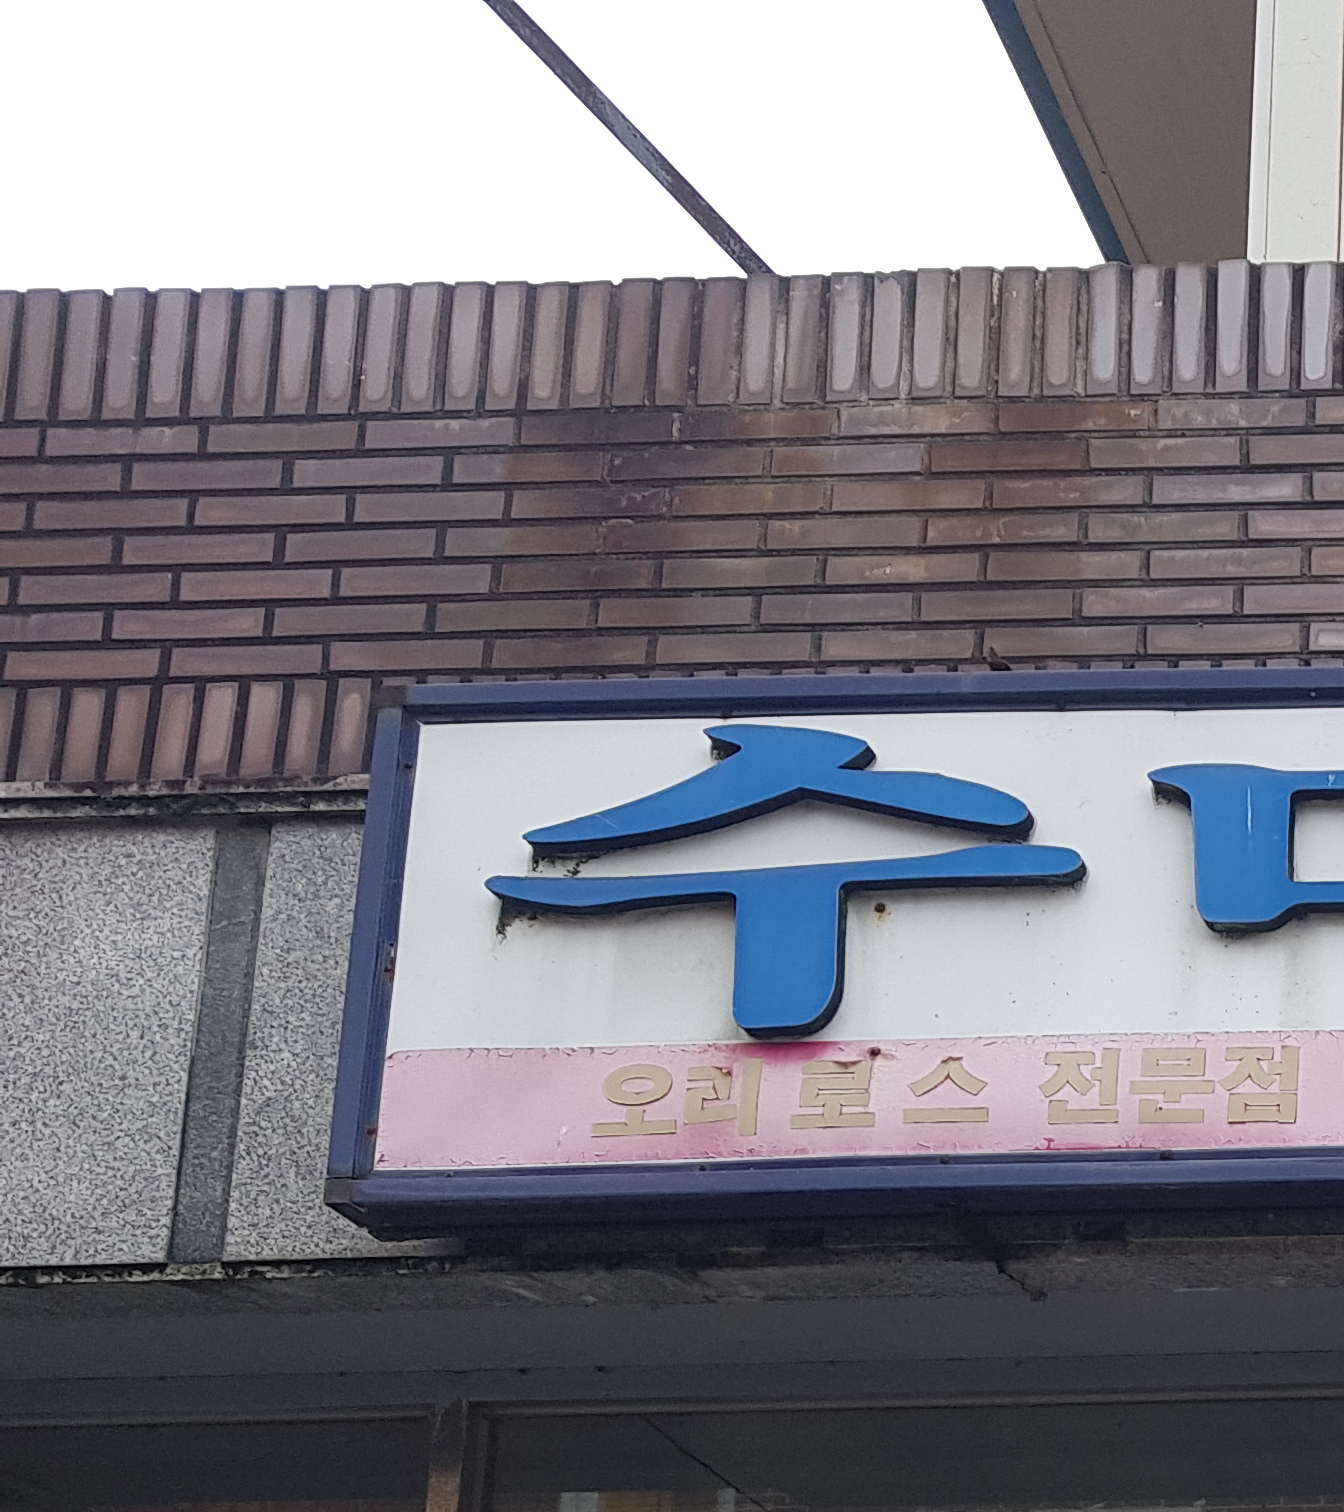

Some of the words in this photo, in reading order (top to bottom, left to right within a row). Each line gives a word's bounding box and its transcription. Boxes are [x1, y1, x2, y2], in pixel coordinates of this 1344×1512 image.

[590, 1057, 763, 1137] 오리
[790, 1055, 990, 1128] 로스
[1040, 1045, 1301, 1126] 전문점
